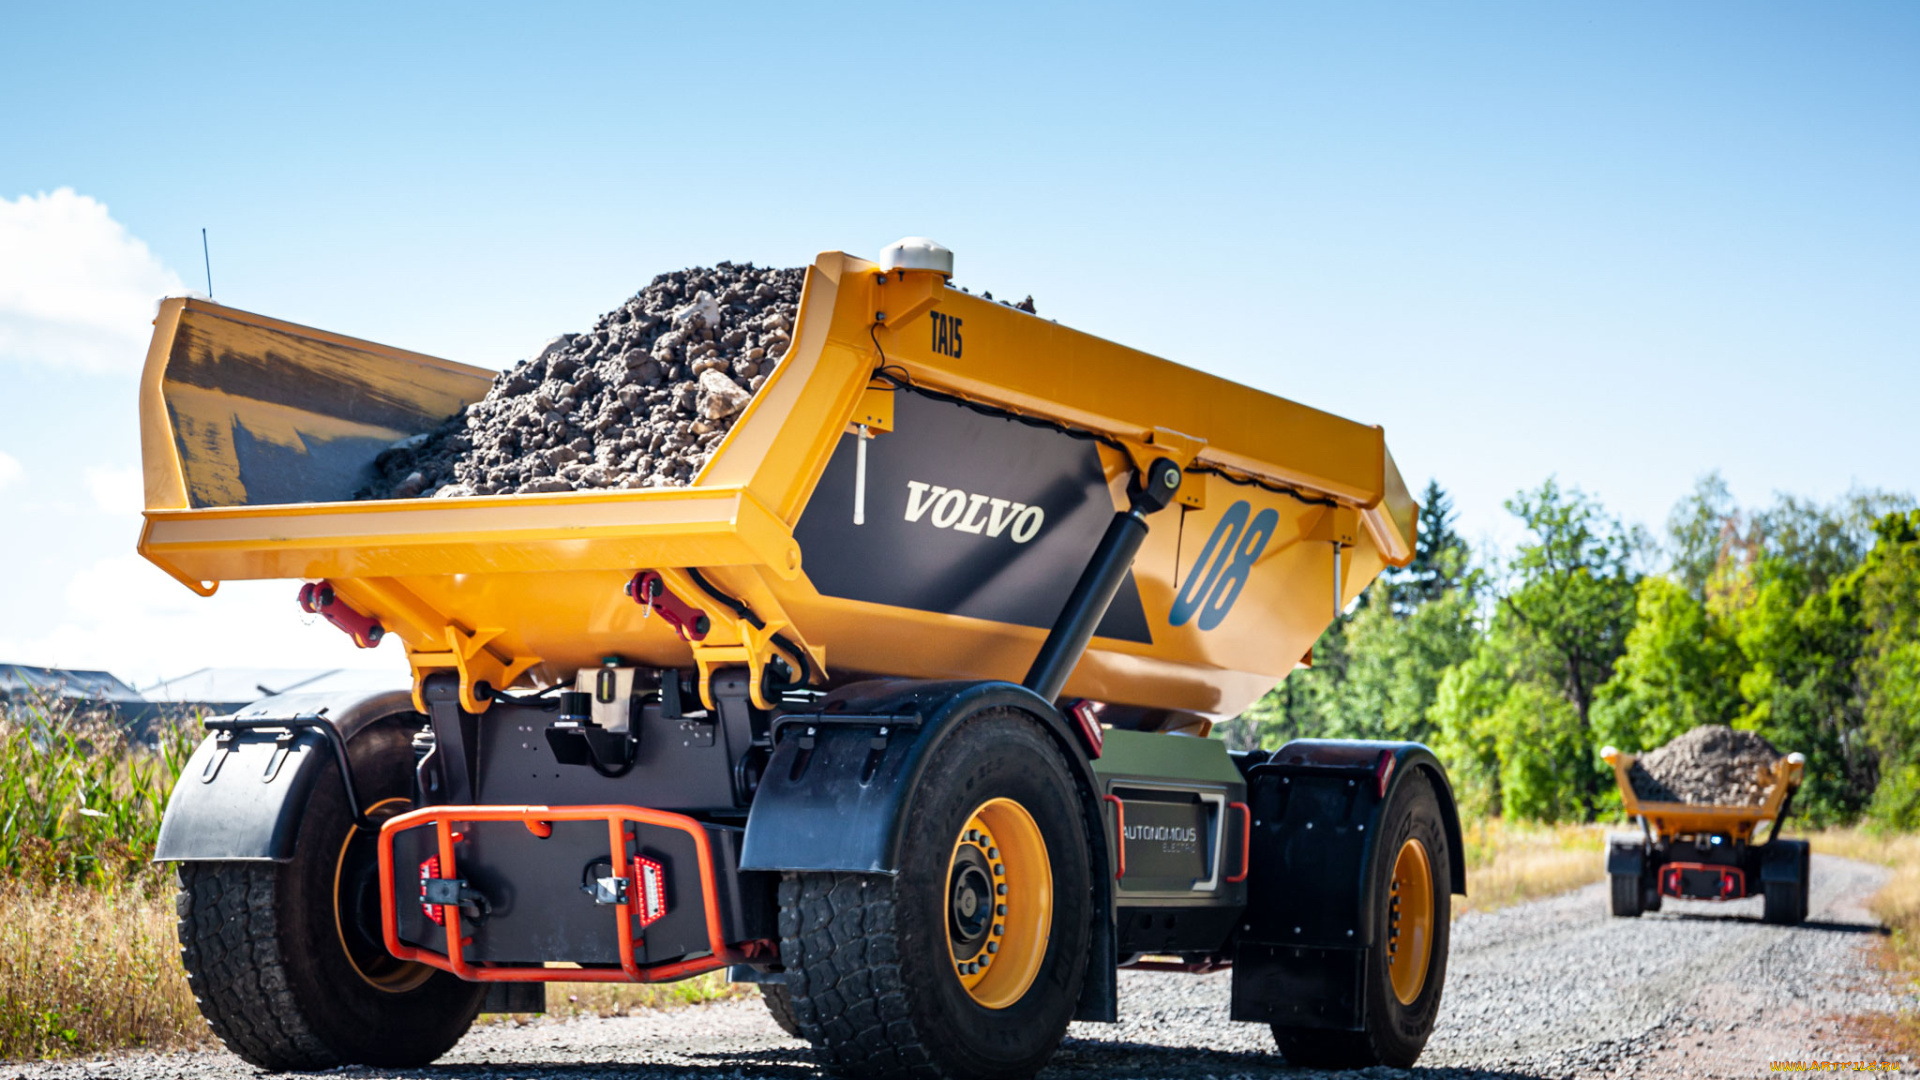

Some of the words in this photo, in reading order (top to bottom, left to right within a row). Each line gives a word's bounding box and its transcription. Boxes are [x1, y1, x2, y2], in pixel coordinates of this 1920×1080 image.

[930, 310, 963, 359] TA15
[904, 480, 1045, 544] VOLVO
[1168, 500, 1279, 631] 08
[1123, 825, 1197, 842] AUTONOMOUS
[1162, 842, 1196, 854] ELECTRC
